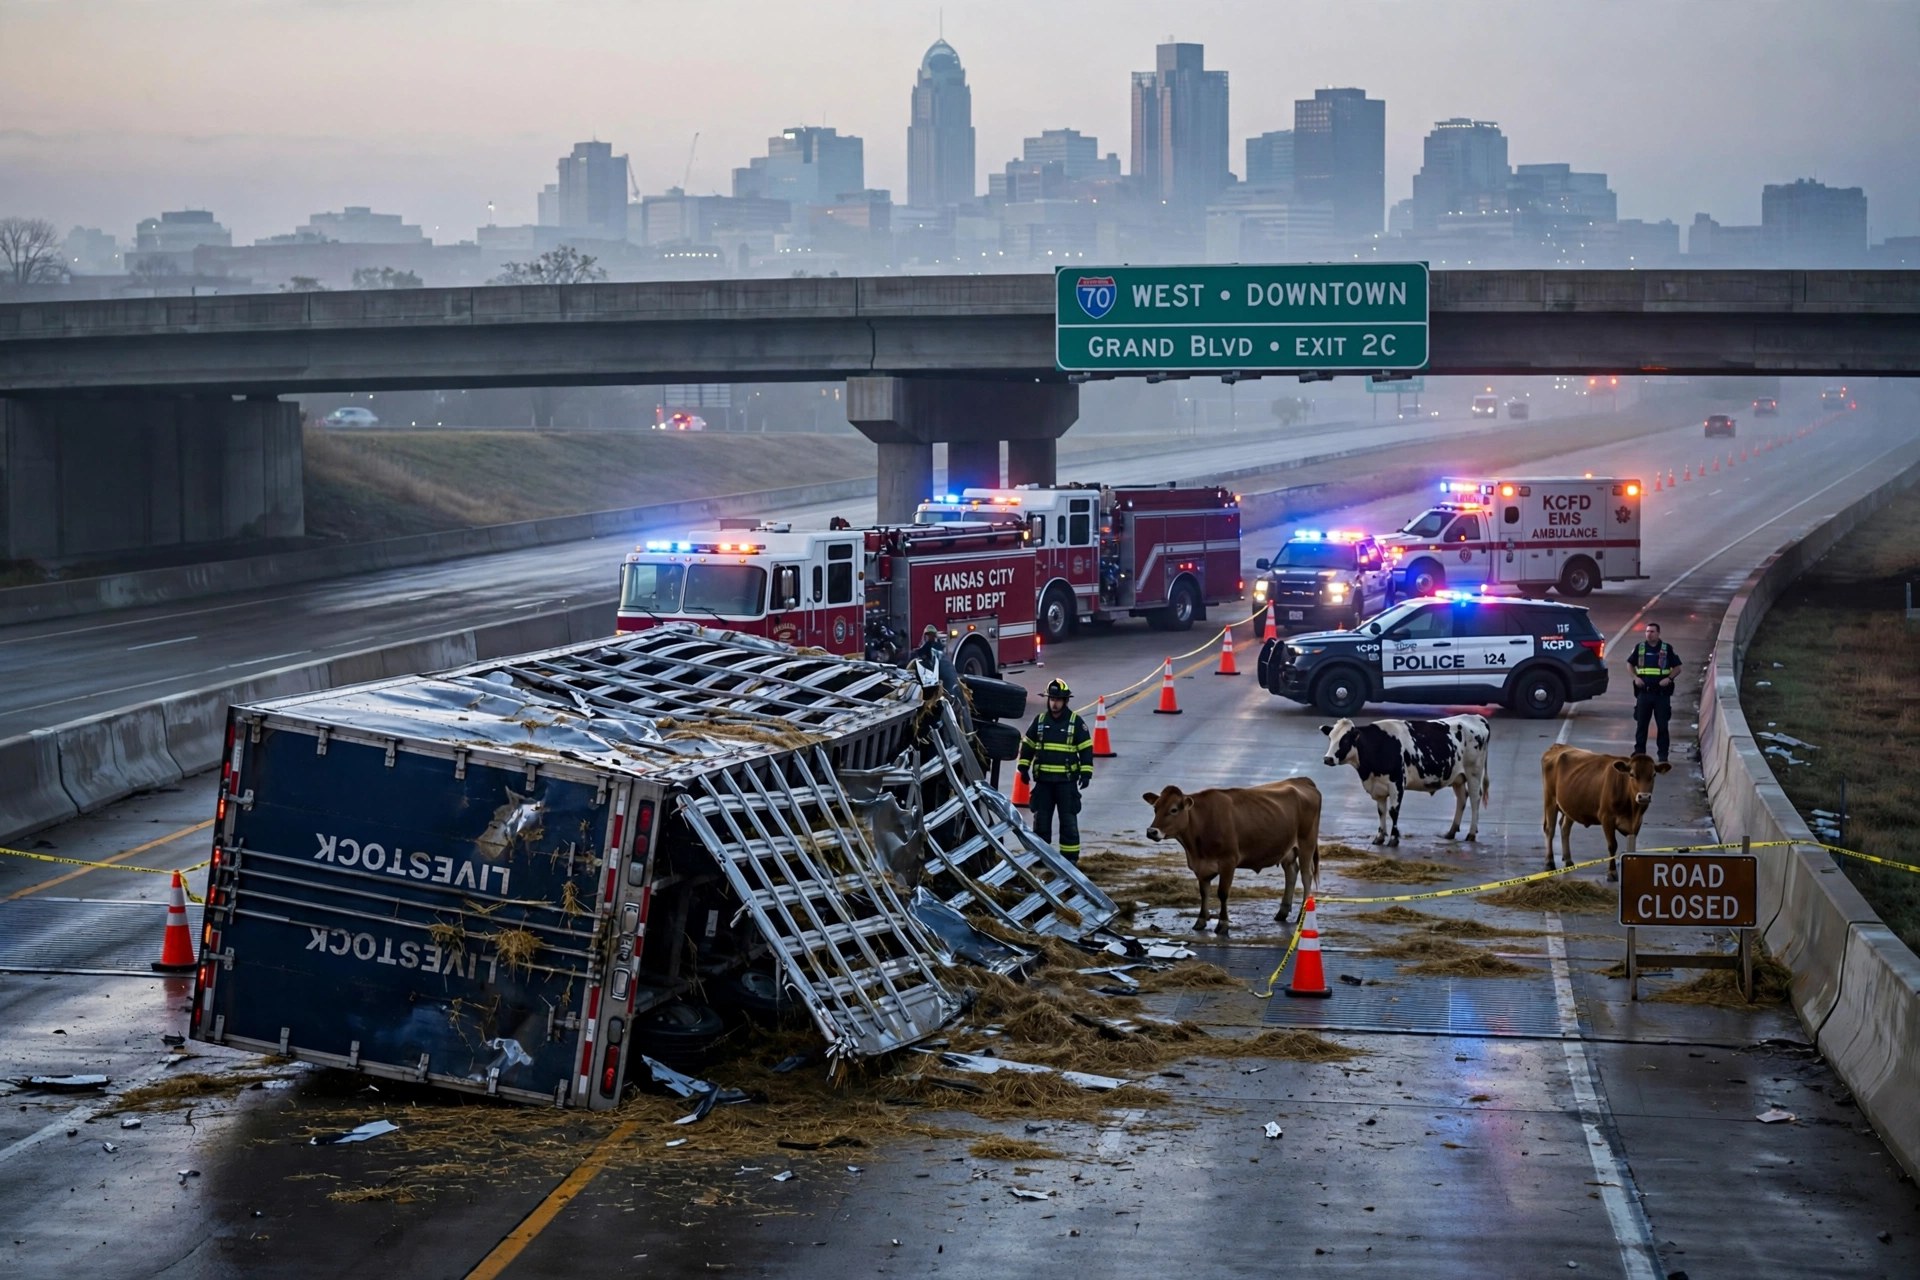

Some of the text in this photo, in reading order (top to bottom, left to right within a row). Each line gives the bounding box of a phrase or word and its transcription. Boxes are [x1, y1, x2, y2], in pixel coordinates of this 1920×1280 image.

[1082, 287, 1110, 308] 70
[1132, 282, 1406, 307] WEST DOWNTOWN
[1088, 334, 1396, 358] GRAND BLVD EXIT 2C
[1543, 495, 1591, 510] KCFD
[1548, 512, 1581, 525] EMS
[1532, 528, 1598, 539] AMBULANCE
[934, 568, 1015, 592] KANSAS CITY
[945, 592, 1006, 613] FIRE DEPT
[1542, 640, 1574, 650] KCPD
[1393, 654, 1465, 670] POLICE
[1484, 652, 1507, 665] 124
[314, 833, 510, 895] LIVESTOCK
[1653, 863, 1724, 888] ROAD
[1638, 894, 1739, 920] CLOSED
[306, 928, 497, 984] LIVESTOCK
